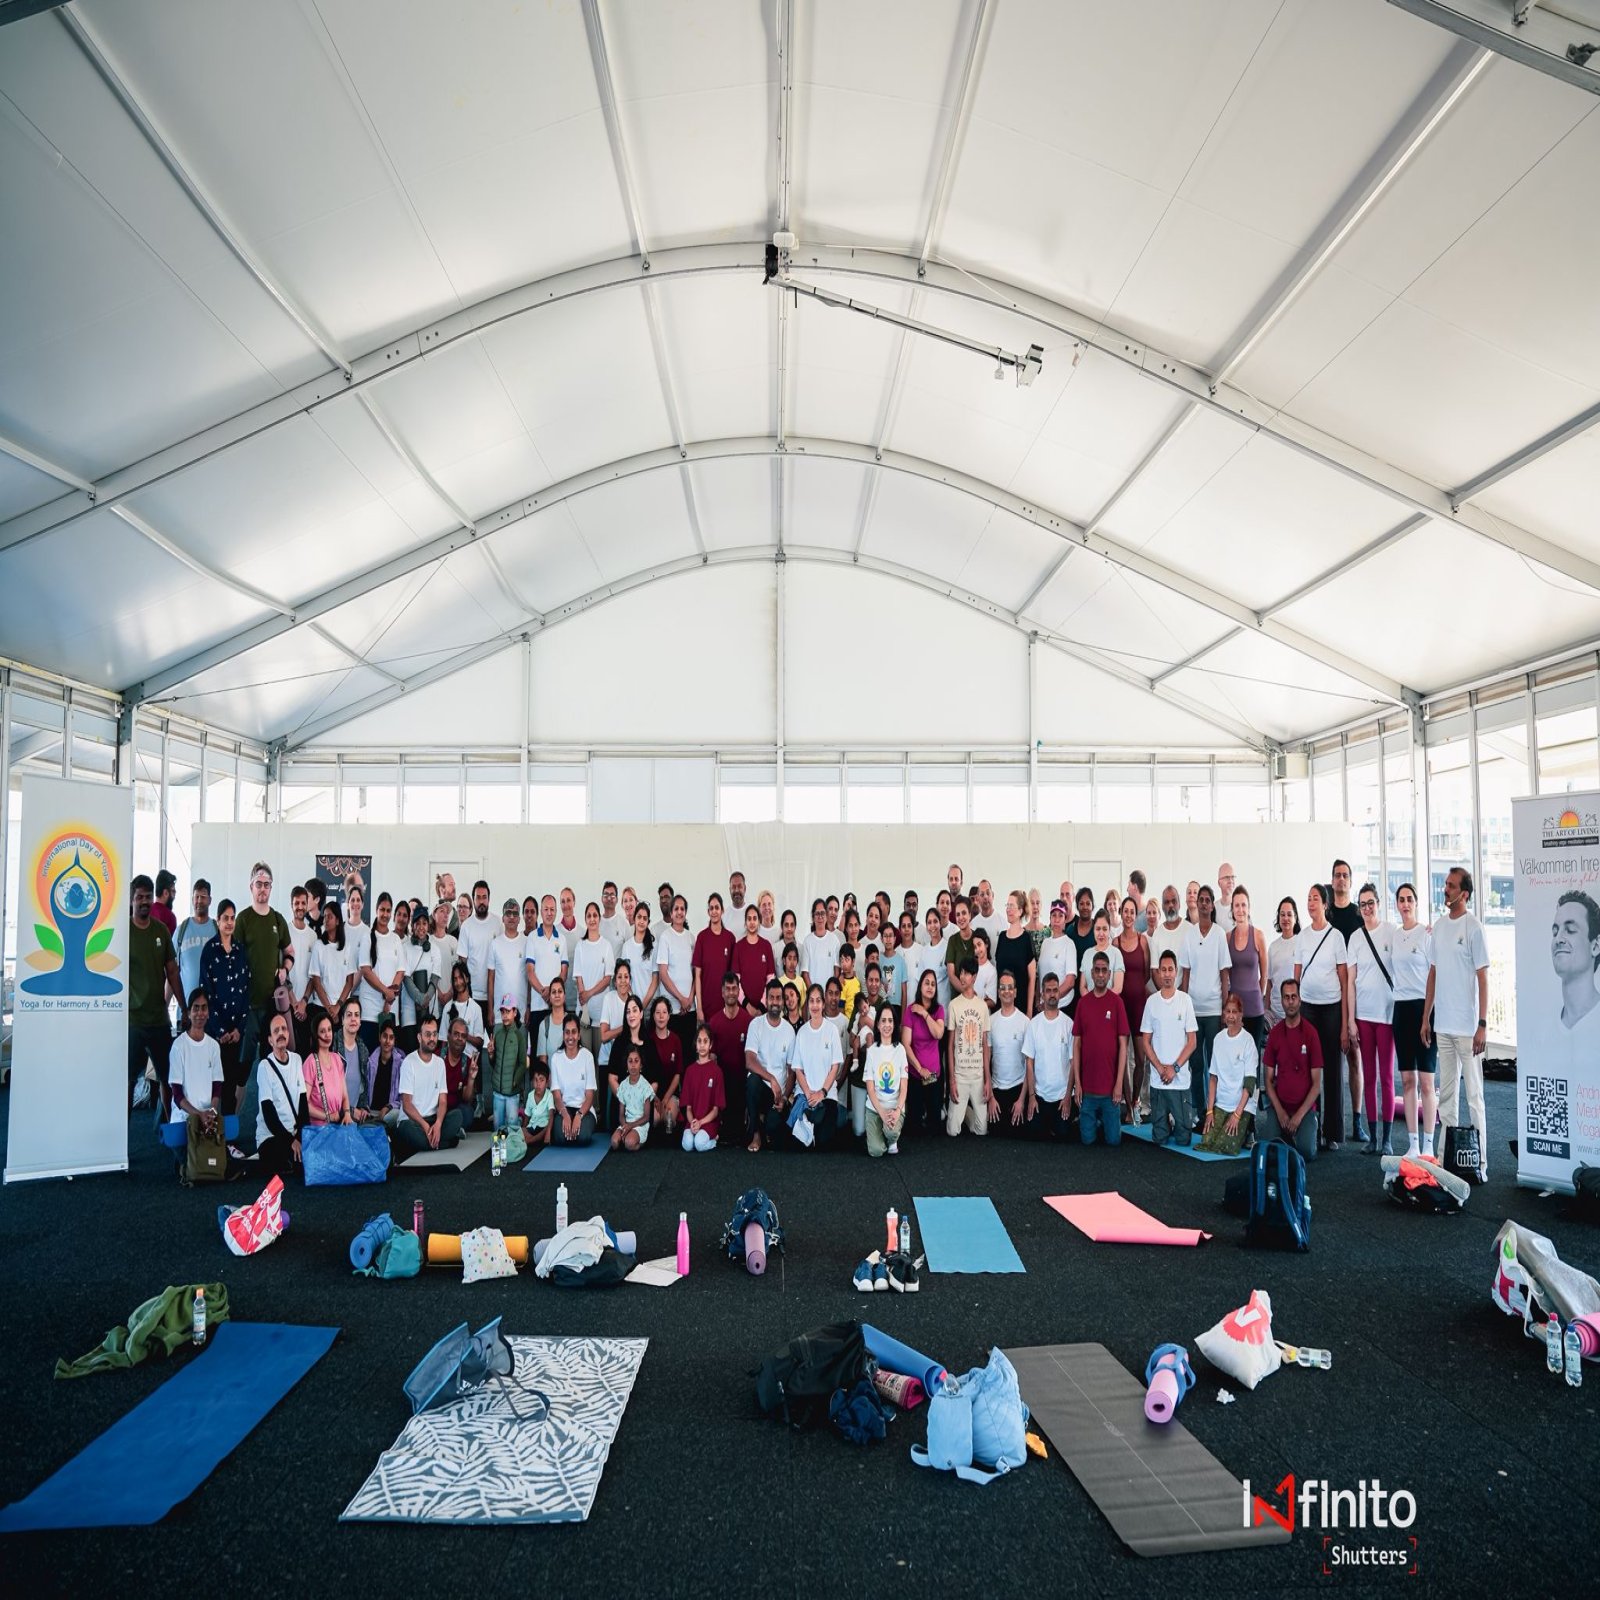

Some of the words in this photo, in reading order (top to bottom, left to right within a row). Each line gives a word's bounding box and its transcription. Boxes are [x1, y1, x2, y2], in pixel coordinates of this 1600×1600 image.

[1577, 827, 1599, 836] LIVING
[41, 838, 78, 878] International
[79, 838, 94, 853] Day
[93, 849, 103, 860] of
[101, 859, 110, 883] Yoga
[1519, 857, 1578, 875] Välkommen
[1580, 855, 1600, 872] Inre
[20, 999, 40, 1010] Yoga
[42, 999, 54, 1009] for
[56, 999, 91, 1011] Harmony
[93, 999, 100, 1009] &
[102, 999, 123, 1009] Peace
[1533, 1140, 1551, 1153] SCAN
[1551, 1143, 1563, 1155] ME
